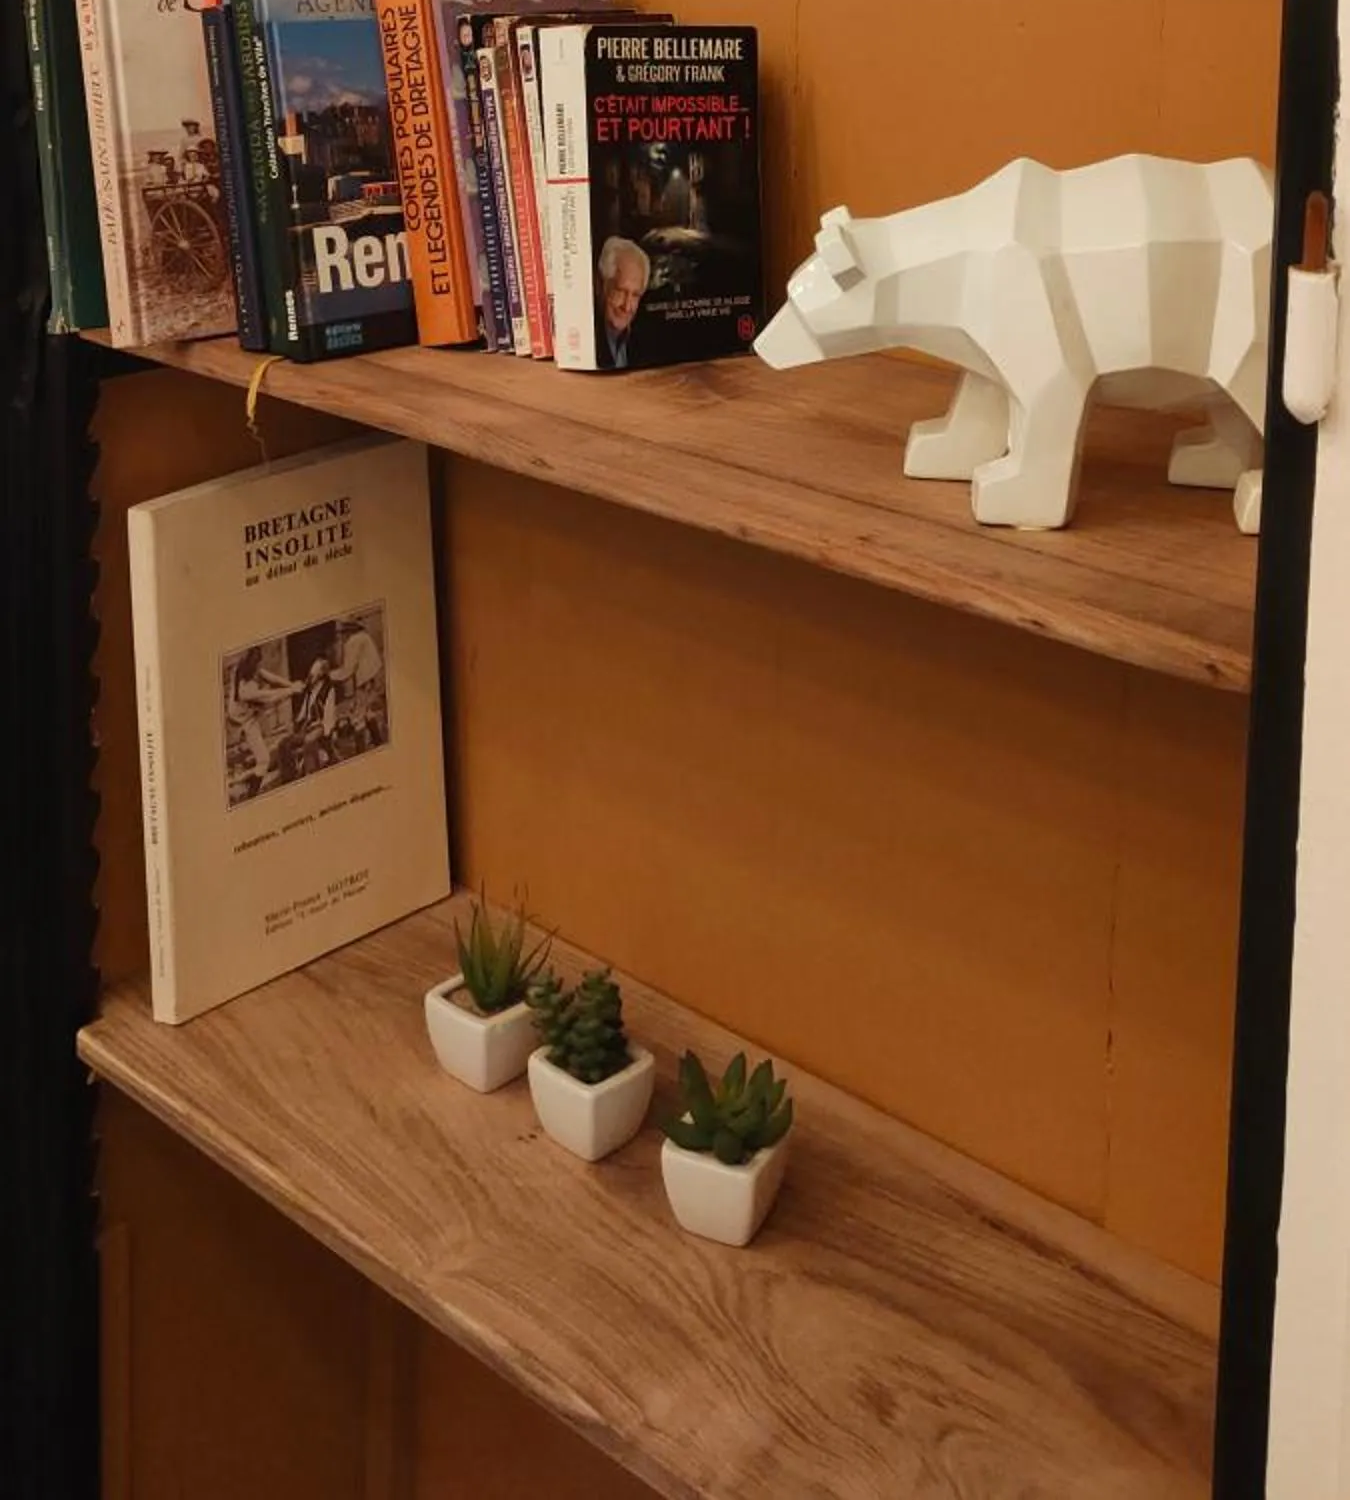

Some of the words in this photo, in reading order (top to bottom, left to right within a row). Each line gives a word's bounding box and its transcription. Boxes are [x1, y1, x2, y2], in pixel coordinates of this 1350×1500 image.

[234, 0, 256, 86] JARDINS
[397, 3, 428, 115] BRETAGNE
[597, 37, 649, 60] PIERRE
[653, 37, 744, 61] BELLEMARE
[380, 7, 410, 139] POPULAIRES
[616, 65, 626, 82] &
[628, 62, 681, 82] GRÉGORY
[685, 65, 725, 82] FRANK
[594, 94, 646, 113] C'ÉTAIT
[597, 117, 623, 141] ET
[628, 116, 736, 141] POURTANT
[745, 116, 751, 139] !
[265, 127, 279, 178] Collection
[413, 121, 433, 149] DE
[397, 145, 420, 231] CONTES
[417, 153, 447, 263] LEGENDES
[430, 268, 450, 295] ET
[285, 289, 299, 341] Rennes
[245, 496, 352, 544] BRETAGNE
[245, 520, 353, 570] INSOLITE
